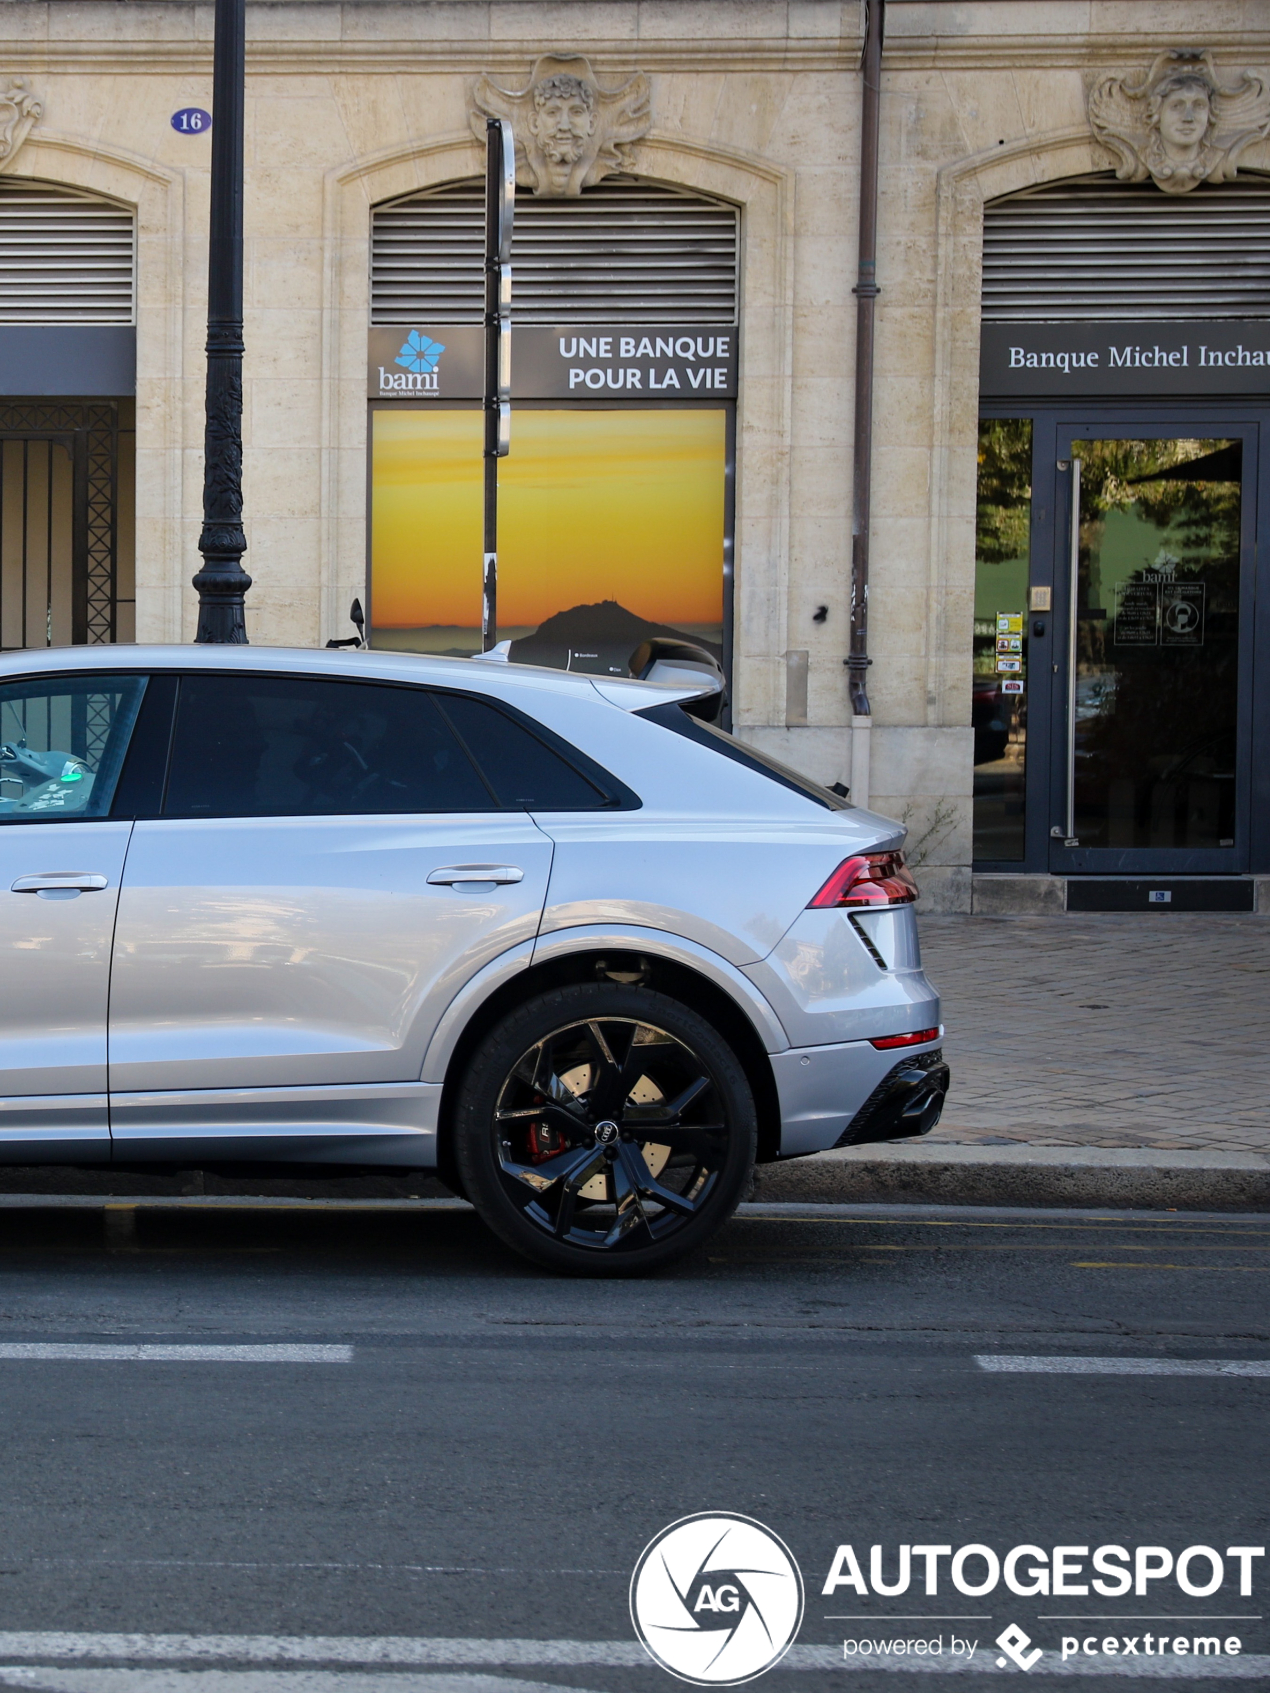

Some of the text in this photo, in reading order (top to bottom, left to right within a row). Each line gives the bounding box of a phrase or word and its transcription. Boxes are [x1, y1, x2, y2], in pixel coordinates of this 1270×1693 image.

[180, 112, 202, 130] 16
[559, 336, 730, 362] UNE BANQUE
[1008, 344, 1270, 374] Banque Michel Incha
[378, 366, 440, 390] bami
[569, 368, 728, 389] POUR LA VIE
